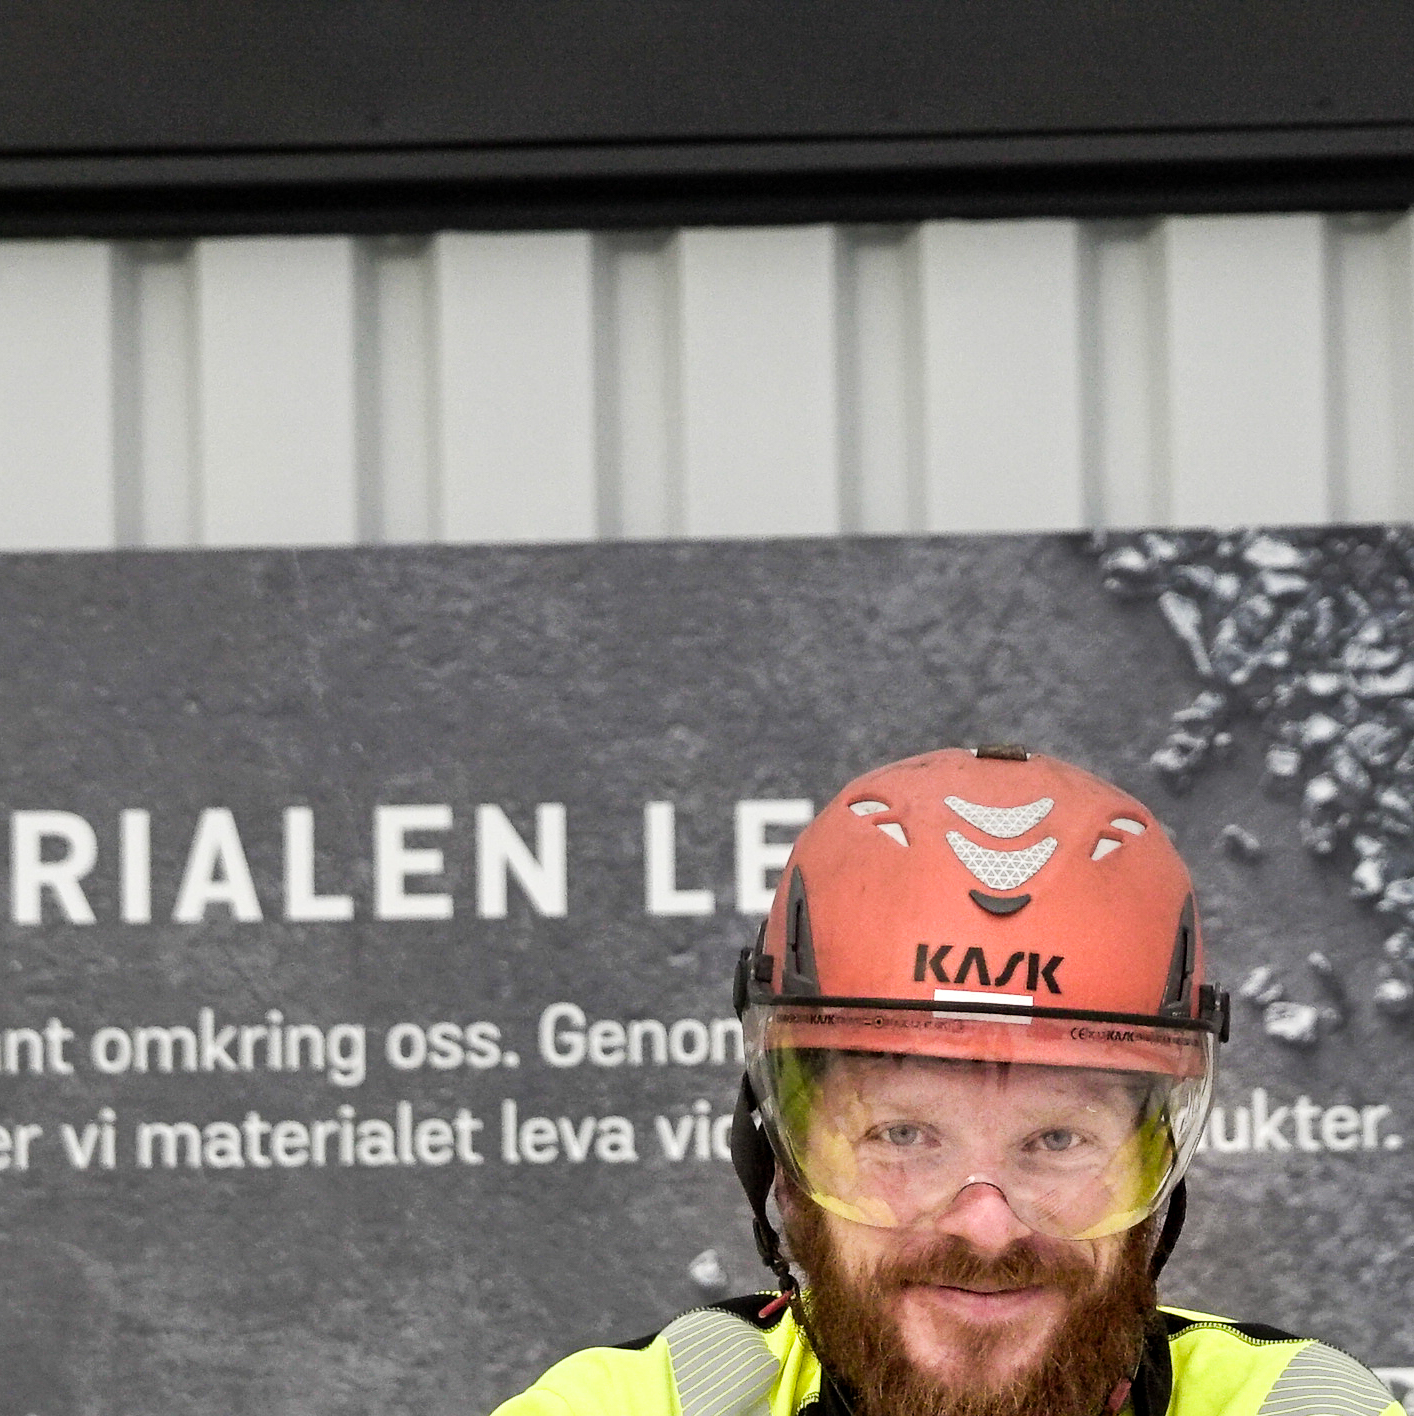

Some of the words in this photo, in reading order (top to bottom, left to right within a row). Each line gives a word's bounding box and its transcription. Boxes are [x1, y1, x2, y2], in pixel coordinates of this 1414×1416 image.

[914, 943, 1064, 994] KASK
[90, 1005, 366, 1087] omkring
[386, 1018, 520, 1070] oss.
[62, 1107, 117, 1171] vi
[136, 1099, 485, 1171] materialet
[501, 1098, 639, 1165] leva
